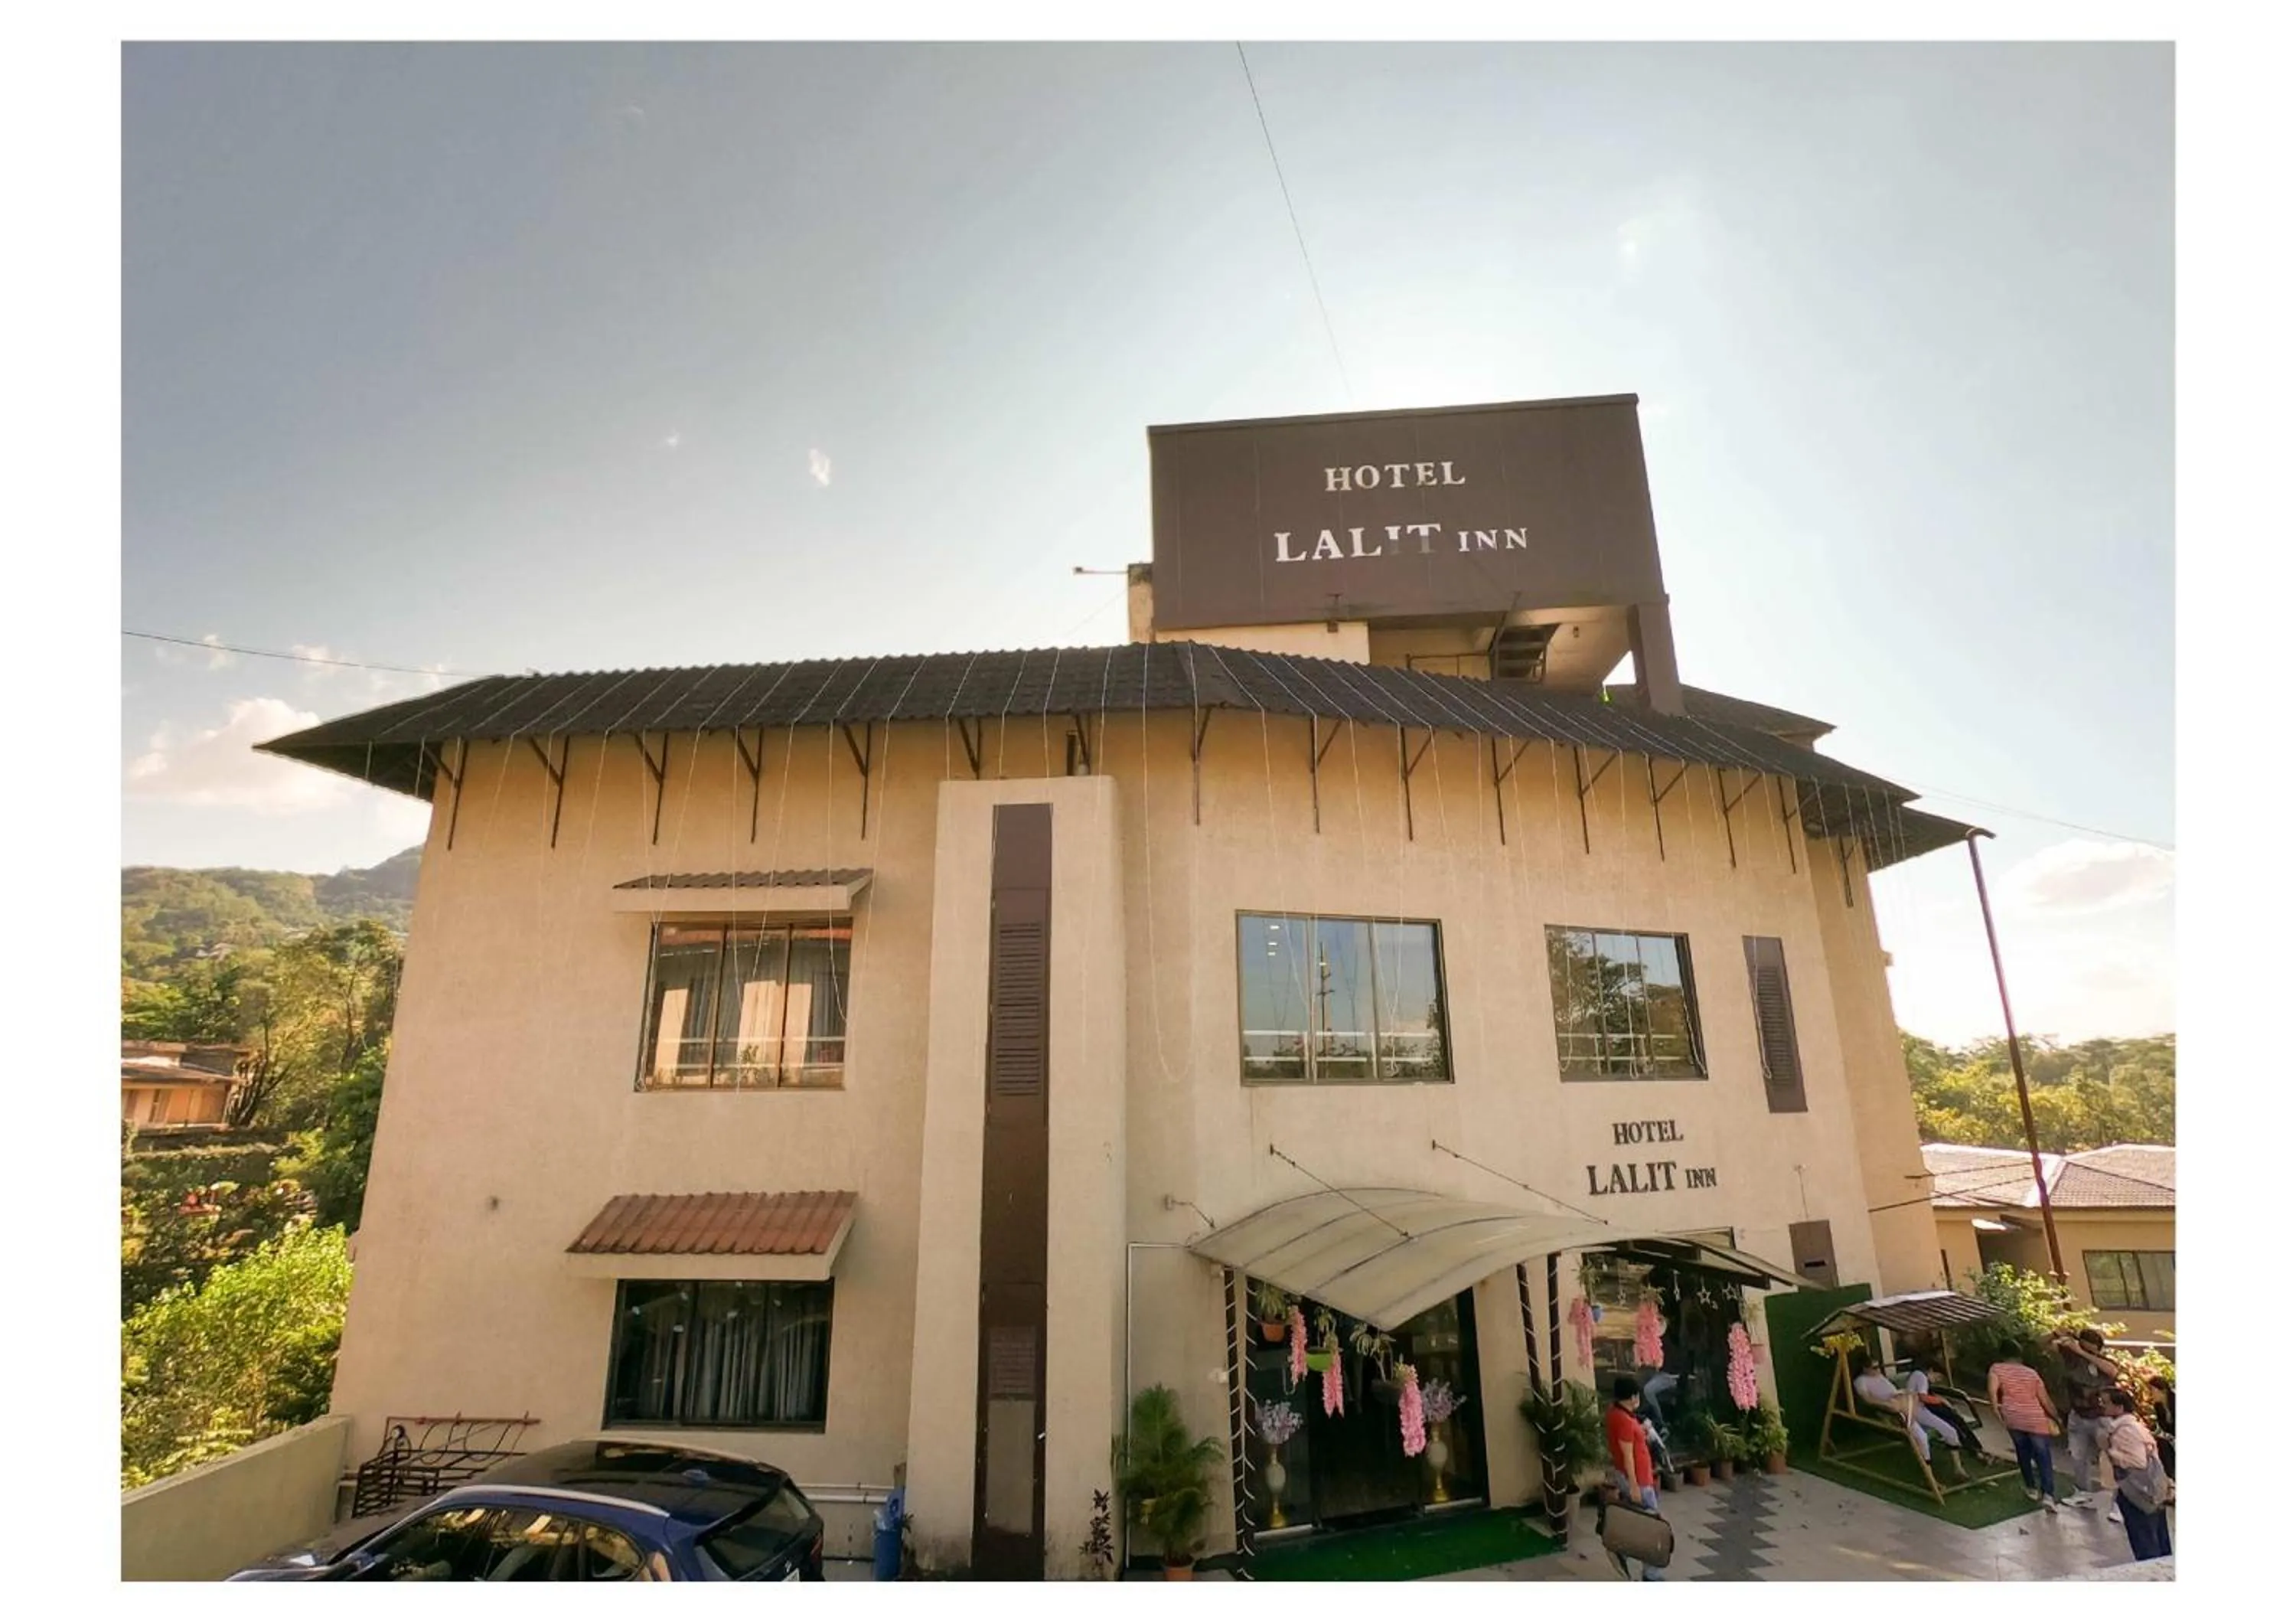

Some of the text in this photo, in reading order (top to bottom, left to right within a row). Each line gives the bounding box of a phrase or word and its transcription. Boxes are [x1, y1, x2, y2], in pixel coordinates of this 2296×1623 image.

[1324, 461, 1466, 491] HOTEL
[1274, 523, 1528, 563] LALIT INN
[1612, 1119, 1684, 1145] HOTEL
[1586, 1161, 1717, 1196] LALIT INN
